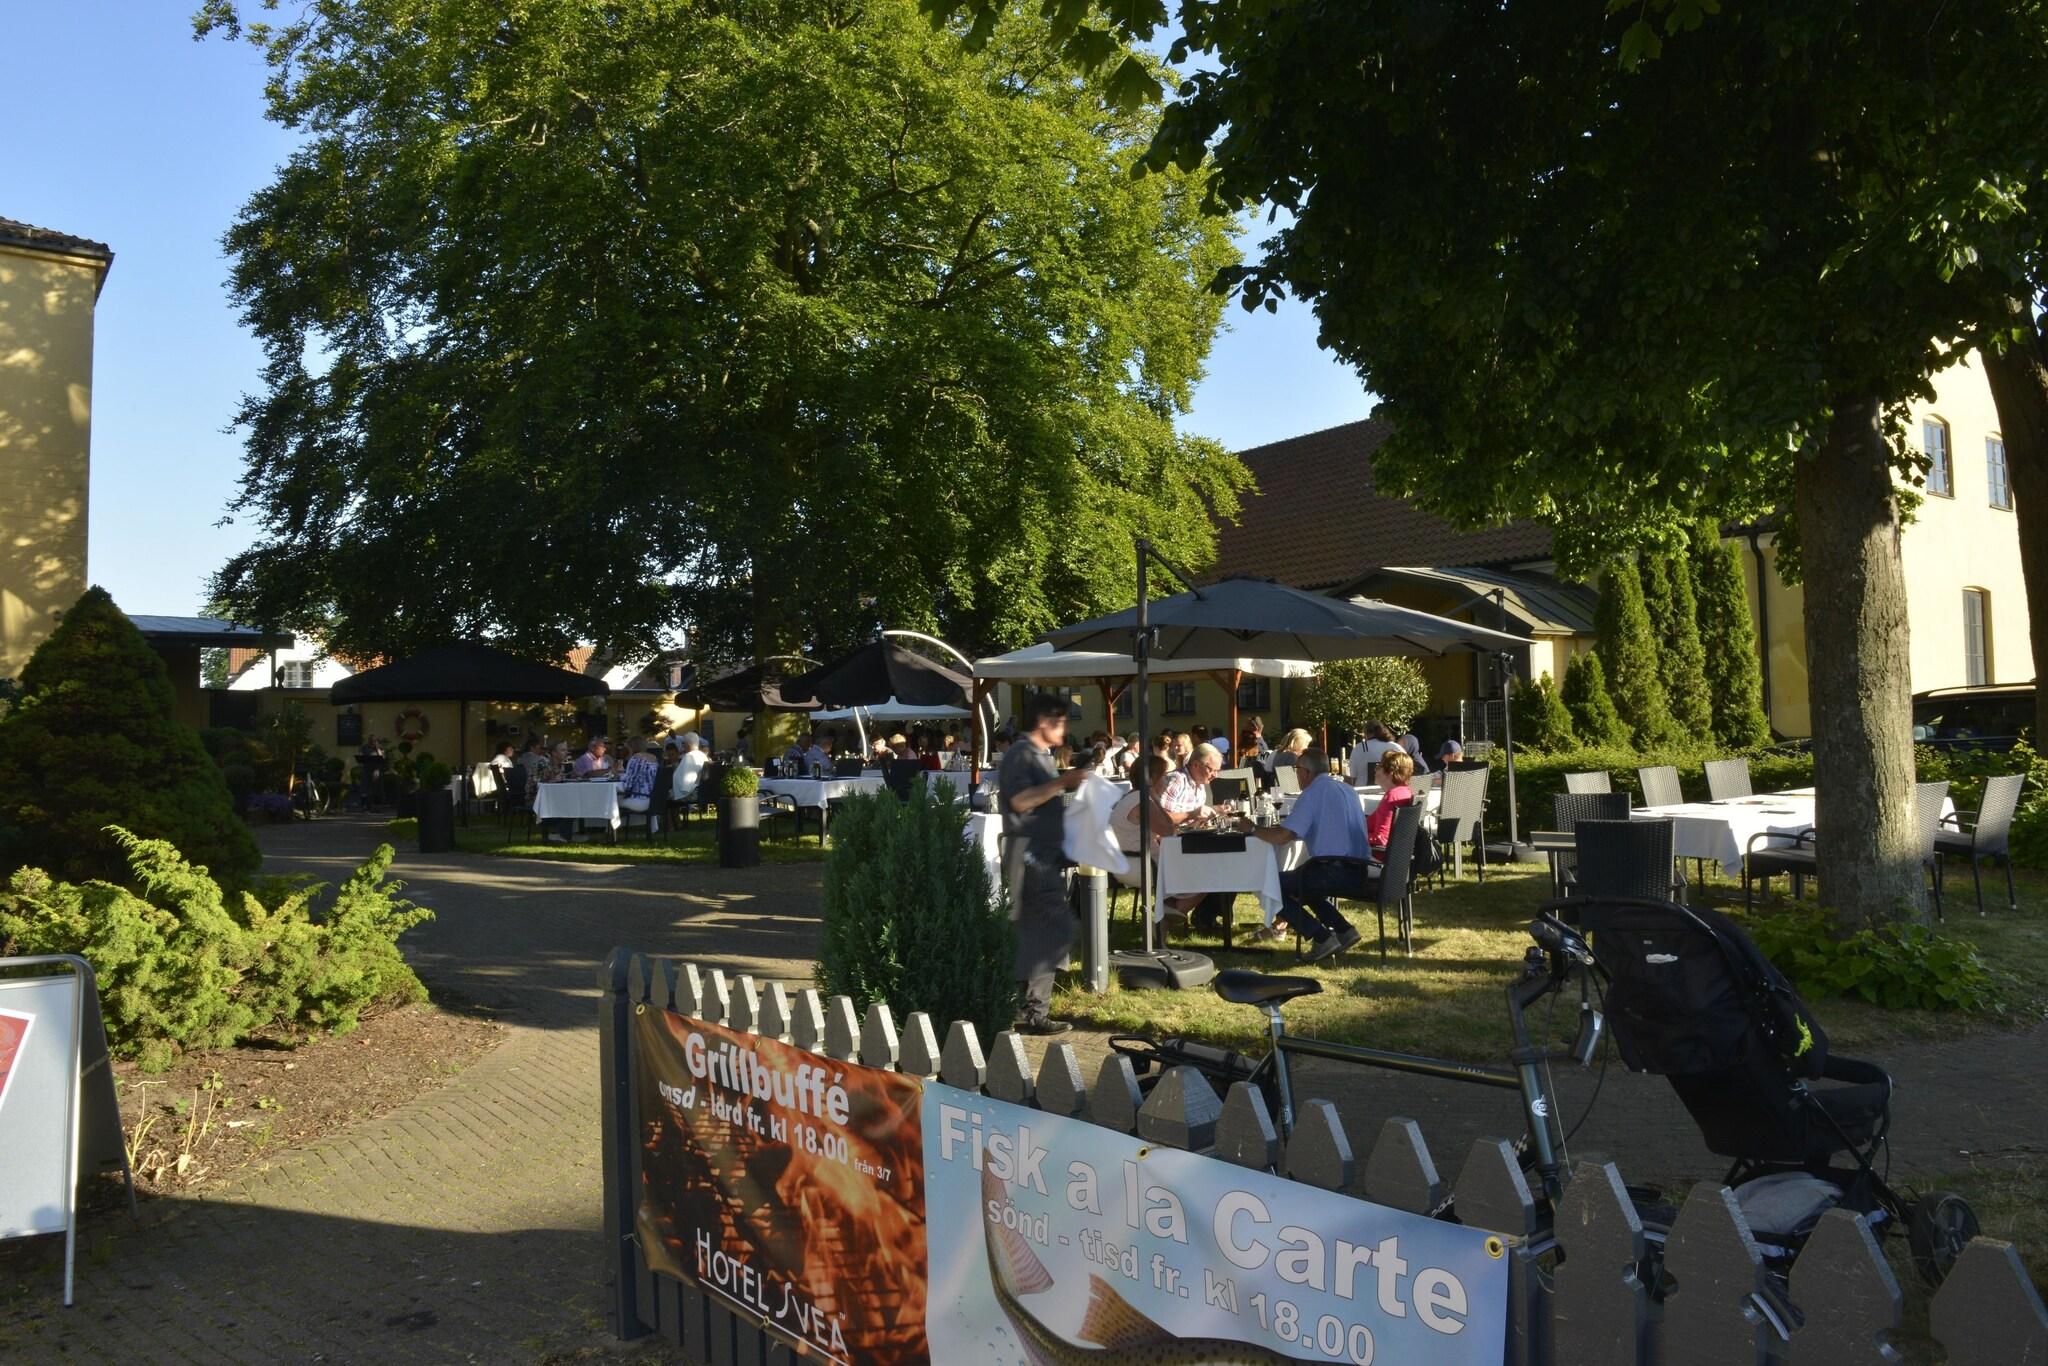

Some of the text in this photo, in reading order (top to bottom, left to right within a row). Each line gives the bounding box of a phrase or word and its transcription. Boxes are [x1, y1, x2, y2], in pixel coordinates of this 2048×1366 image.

[659, 1081, 696, 1109] onsd
[747, 1107, 766, 1135] fr.
[770, 1114, 787, 1143] kl
[794, 1123, 848, 1165] 18.00
[685, 1032, 850, 1126] Grillbuffé
[854, 1158, 891, 1182] från 3/7
[939, 1103, 1468, 1335] Fisk a la Carte
[696, 1227, 849, 1357] HOTEL SVEA
[988, 1198, 1049, 1247] sönd
[1079, 1227, 1140, 1281] tisd
[1150, 1254, 1189, 1299] fr.
[1204, 1268, 1239, 1315] kl
[1250, 1292, 1375, 1366] 18.00
